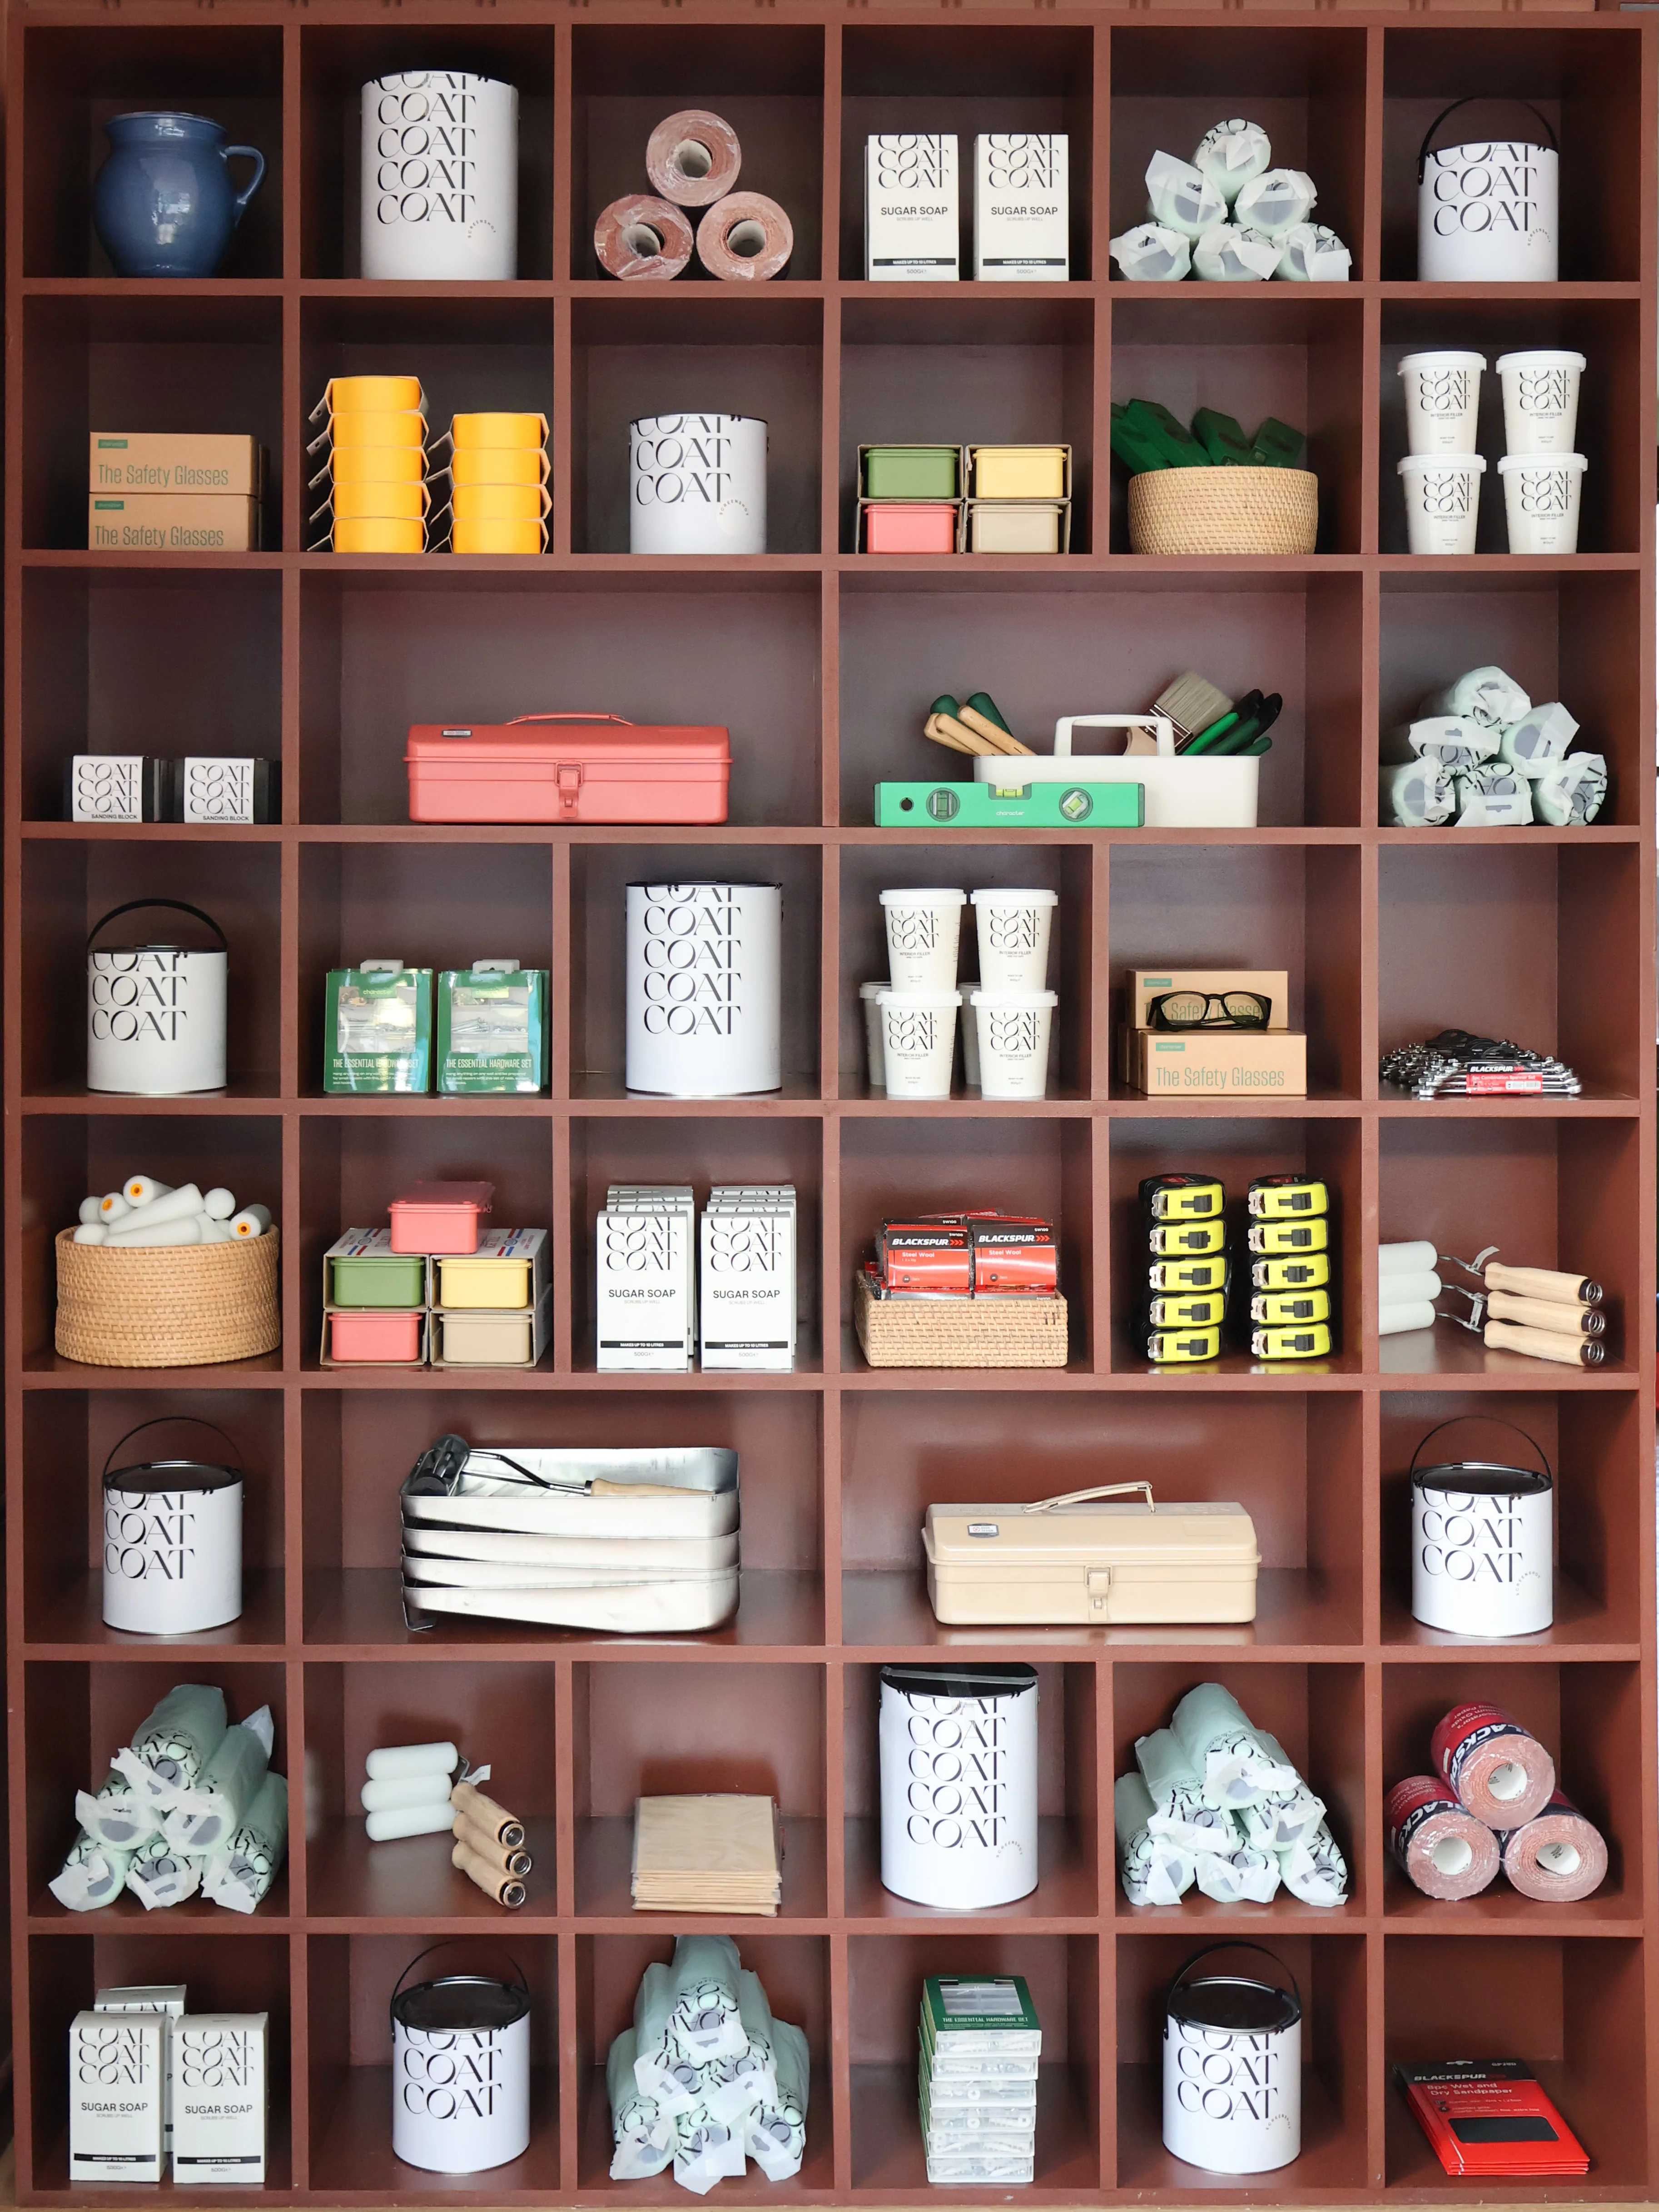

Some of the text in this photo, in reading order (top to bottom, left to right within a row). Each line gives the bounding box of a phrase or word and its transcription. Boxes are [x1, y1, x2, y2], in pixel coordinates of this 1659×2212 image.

[378, 93, 476, 124] COAT
[378, 126, 476, 158] COAT
[878, 149, 949, 169] COAT
[988, 149, 1059, 169] COAT
[377, 159, 476, 191] COAT
[878, 169, 949, 189] COAT
[988, 169, 1059, 188] COAT
[1434, 166, 1537, 201] COAT
[377, 193, 476, 224] COAT
[881, 207, 948, 215] SUGAR SOAP
[991, 207, 1058, 215] SUGAR SOAP
[1434, 201, 1537, 236] COAT
[1420, 380, 1470, 395] COAT
[1520, 379, 1570, 395] COAT
[1421, 394, 1470, 411] COAT
[1520, 394, 1570, 410] COAT
[636, 438, 731, 471] COAT
[99, 464, 228, 487] The Safety Glasses
[636, 472, 731, 505] COAT
[1424, 482, 1473, 497] COAT
[1521, 480, 1572, 496] COAT
[1424, 497, 1472, 512] COAT
[1521, 495, 1572, 511] COAT
[95, 526, 224, 548] The Safety Glasses
[78, 763, 138, 780] COAT
[190, 765, 249, 781] COAT
[78, 780, 138, 796] COAT
[190, 781, 249, 798] COAT
[78, 796, 137, 813] COAT
[190, 798, 249, 814] COAT
[644, 906, 742, 935] COAT
[891, 919, 939, 935] COAT
[990, 918, 1040, 933] COAT
[892, 933, 939, 949] COAT
[990, 932, 1040, 948] COAT
[644, 939, 742, 968] COAT
[93, 975, 188, 1006] COAT
[644, 972, 742, 1001] COAT
[93, 1009, 188, 1041] COAT
[644, 1004, 742, 1035] COAT
[889, 1020, 937, 1036] COAT
[990, 1020, 1040, 1036] COAT
[889, 1034, 937, 1050] COAT
[990, 1035, 1040, 1051] COAT
[333, 1059, 374, 1068] THE ESSENTIAL
[447, 1059, 532, 1068] THE ESSENTIAL HARDWARE SET
[1156, 1067, 1284, 1089] The Safety Glasses
[606, 1231, 677, 1251] COAT
[710, 1233, 781, 1252] COAT
[606, 1251, 677, 1271] COAT
[710, 1252, 781, 1272] COAT
[609, 1289, 676, 1297] SUGAR SOAP
[713, 1290, 780, 1298] SUGAR SOAP
[105, 1509, 195, 1545] COAT
[1422, 1510, 1523, 1548] COAT
[105, 1543, 195, 1579] COAT
[1422, 1544, 1523, 1582] COAT
[908, 1716, 1007, 1749] COAT
[908, 1749, 1007, 1782] COAT
[908, 1782, 1007, 1815] COAT
[907, 1815, 1007, 1848] COAT
[79, 2044, 149, 2064] COAT
[182, 2047, 254, 2067] COAT
[79, 2064, 149, 2084] COAT
[404, 2048, 502, 2084] COAT
[1177, 2046, 1278, 2086] COAT
[182, 2067, 254, 2087] COAT
[81, 2103, 148, 2111] SUGAR SOAP
[185, 2105, 253, 2114] SUGAR SOAP
[404, 2083, 502, 2119] COAT
[1177, 2080, 1278, 2120] COAT
